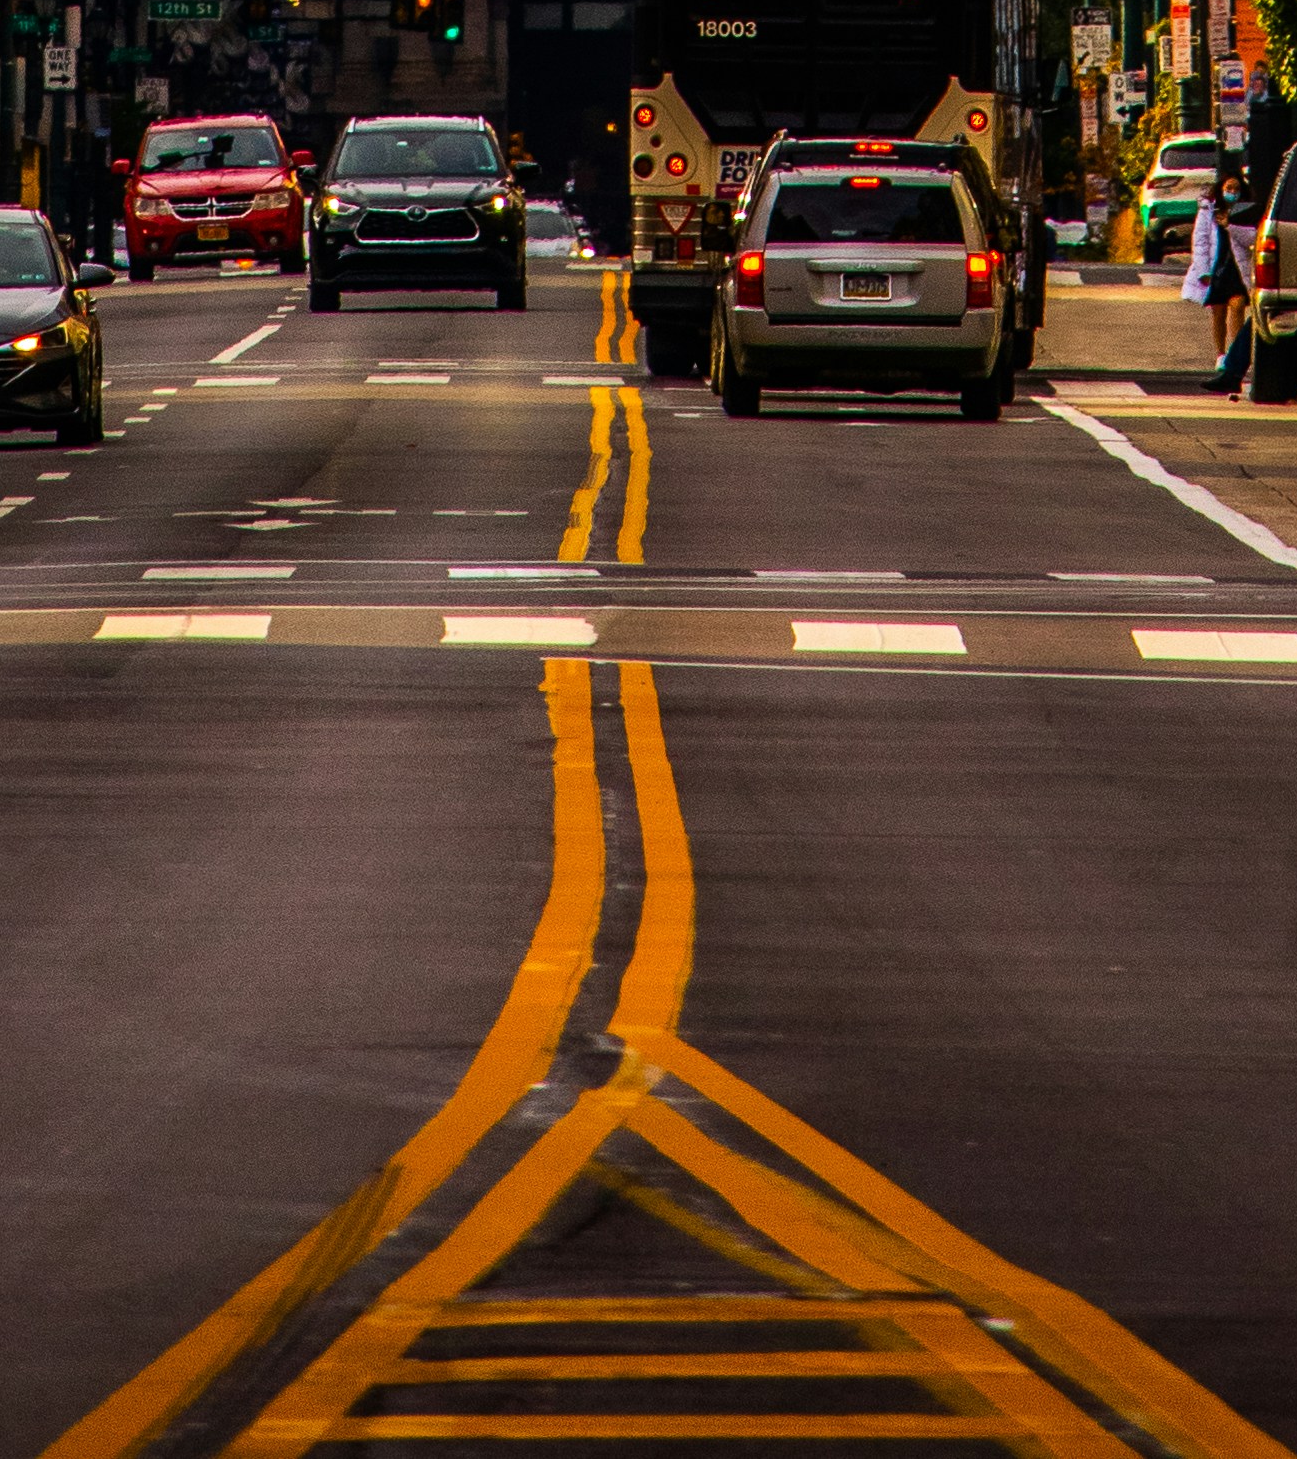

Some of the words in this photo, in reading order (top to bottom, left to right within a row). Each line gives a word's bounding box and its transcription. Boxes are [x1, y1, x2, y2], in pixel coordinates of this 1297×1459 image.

[157, 3, 189, 14] 12th
[196, 2, 213, 14] St
[697, 21, 758, 38] 18003
[48, 50, 71, 60] ONE
[49, 61, 70, 71] WAY
